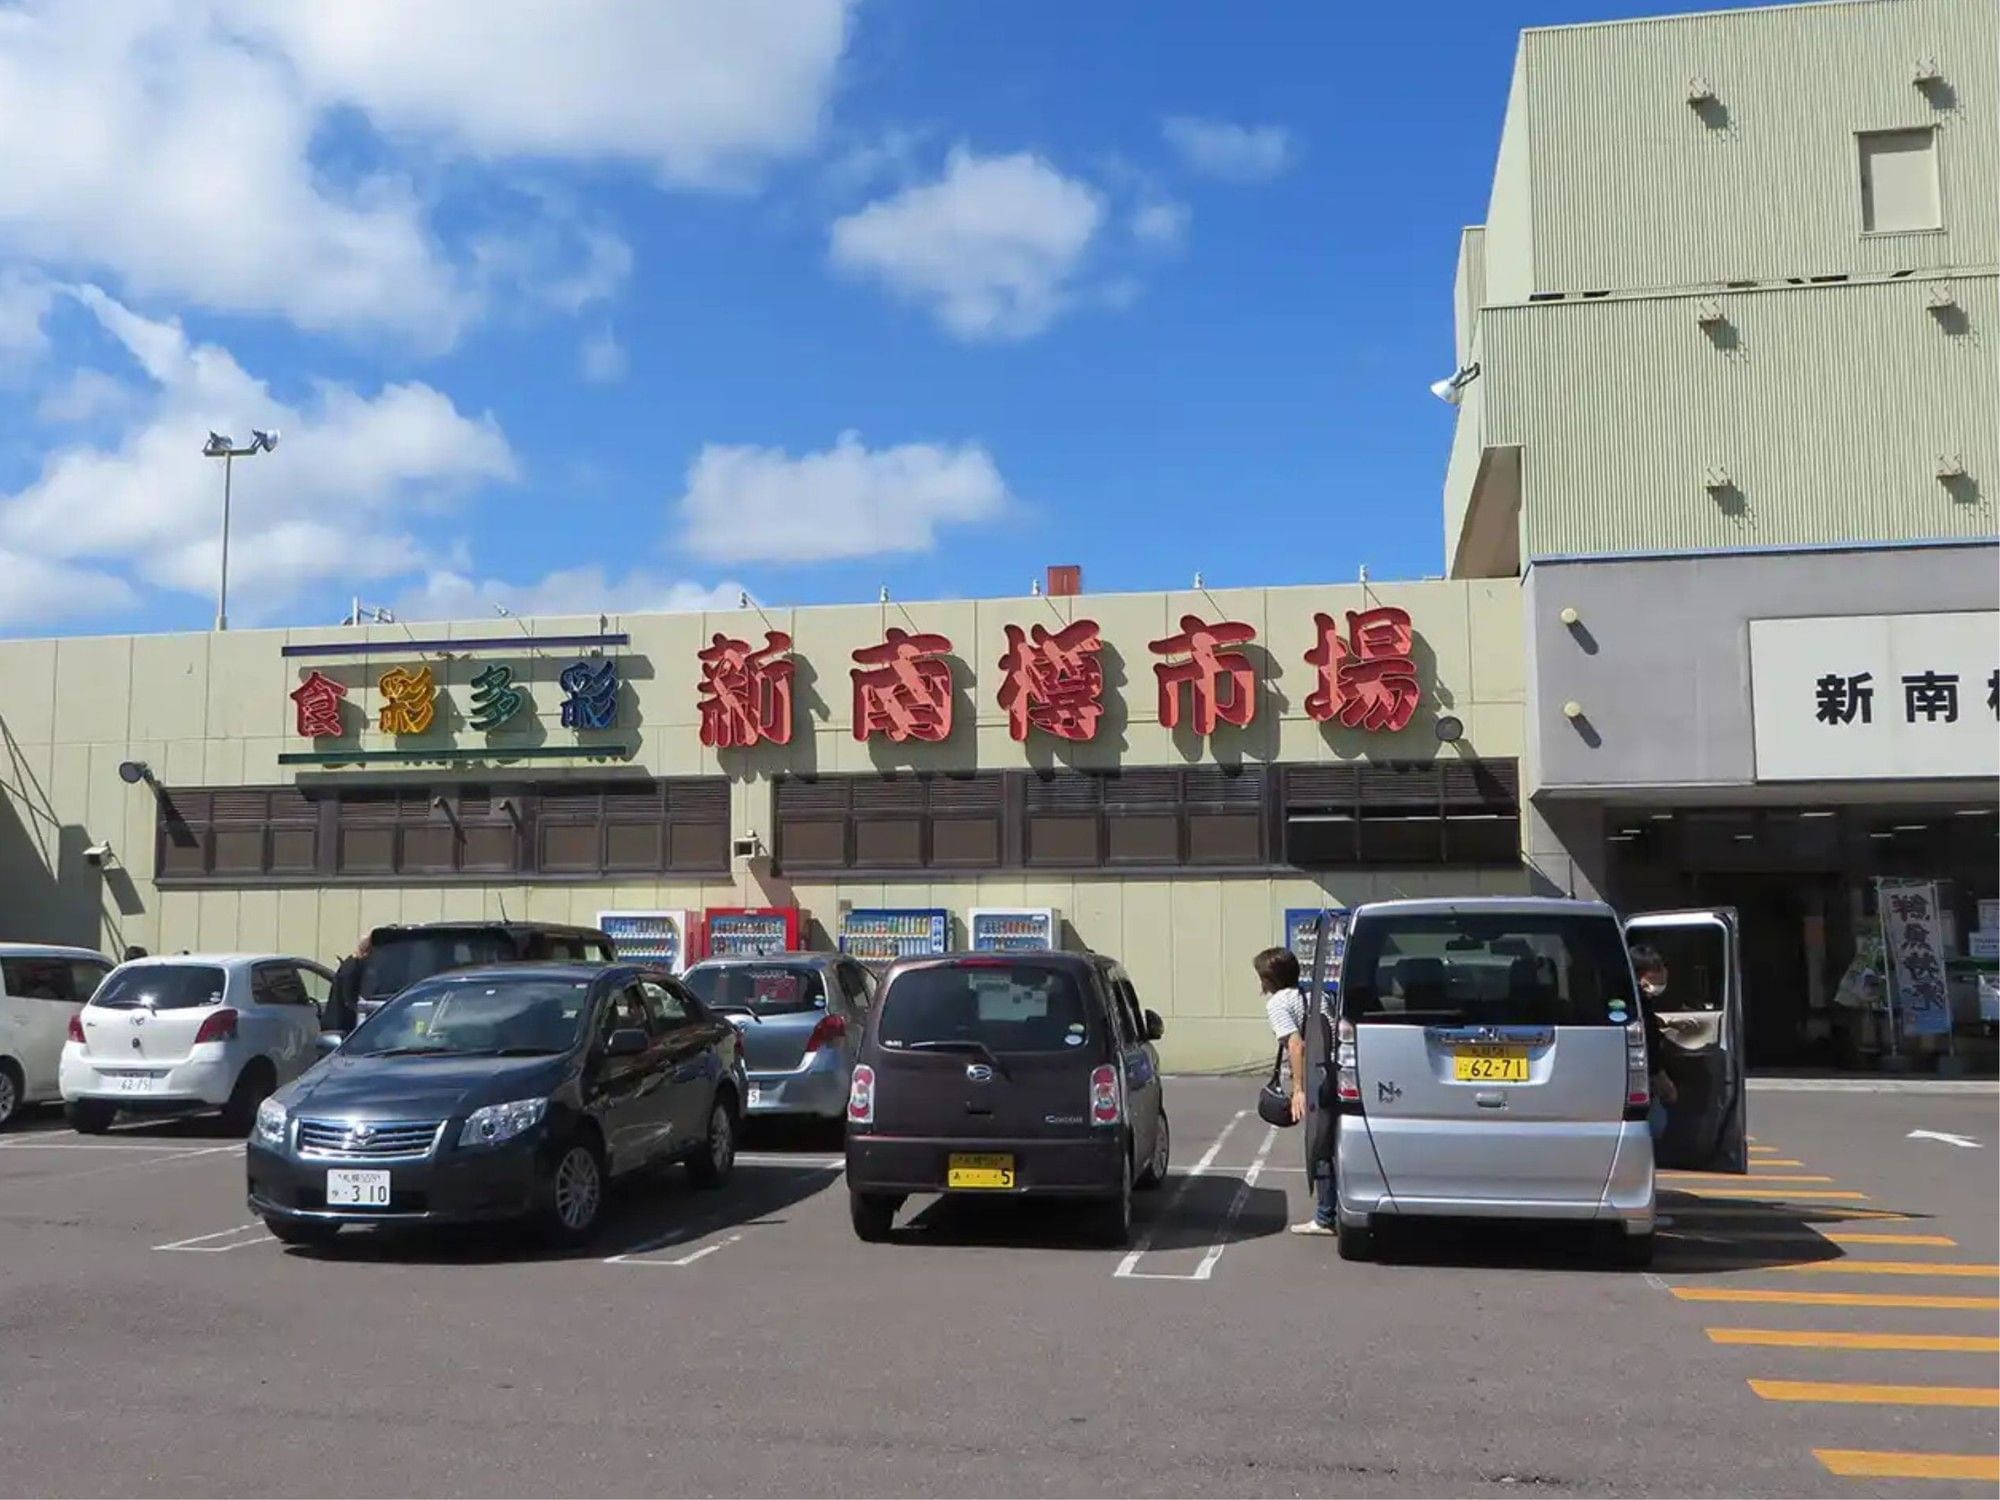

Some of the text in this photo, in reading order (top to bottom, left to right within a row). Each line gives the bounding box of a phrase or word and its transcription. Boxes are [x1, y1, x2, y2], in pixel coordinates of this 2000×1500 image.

[290, 659, 618, 738] 食彩多彩
[697, 606, 1423, 747] 新南樽市場
[1814, 669, 1999, 725] 新南
[1470, 1059, 1522, 1077] 62-71
